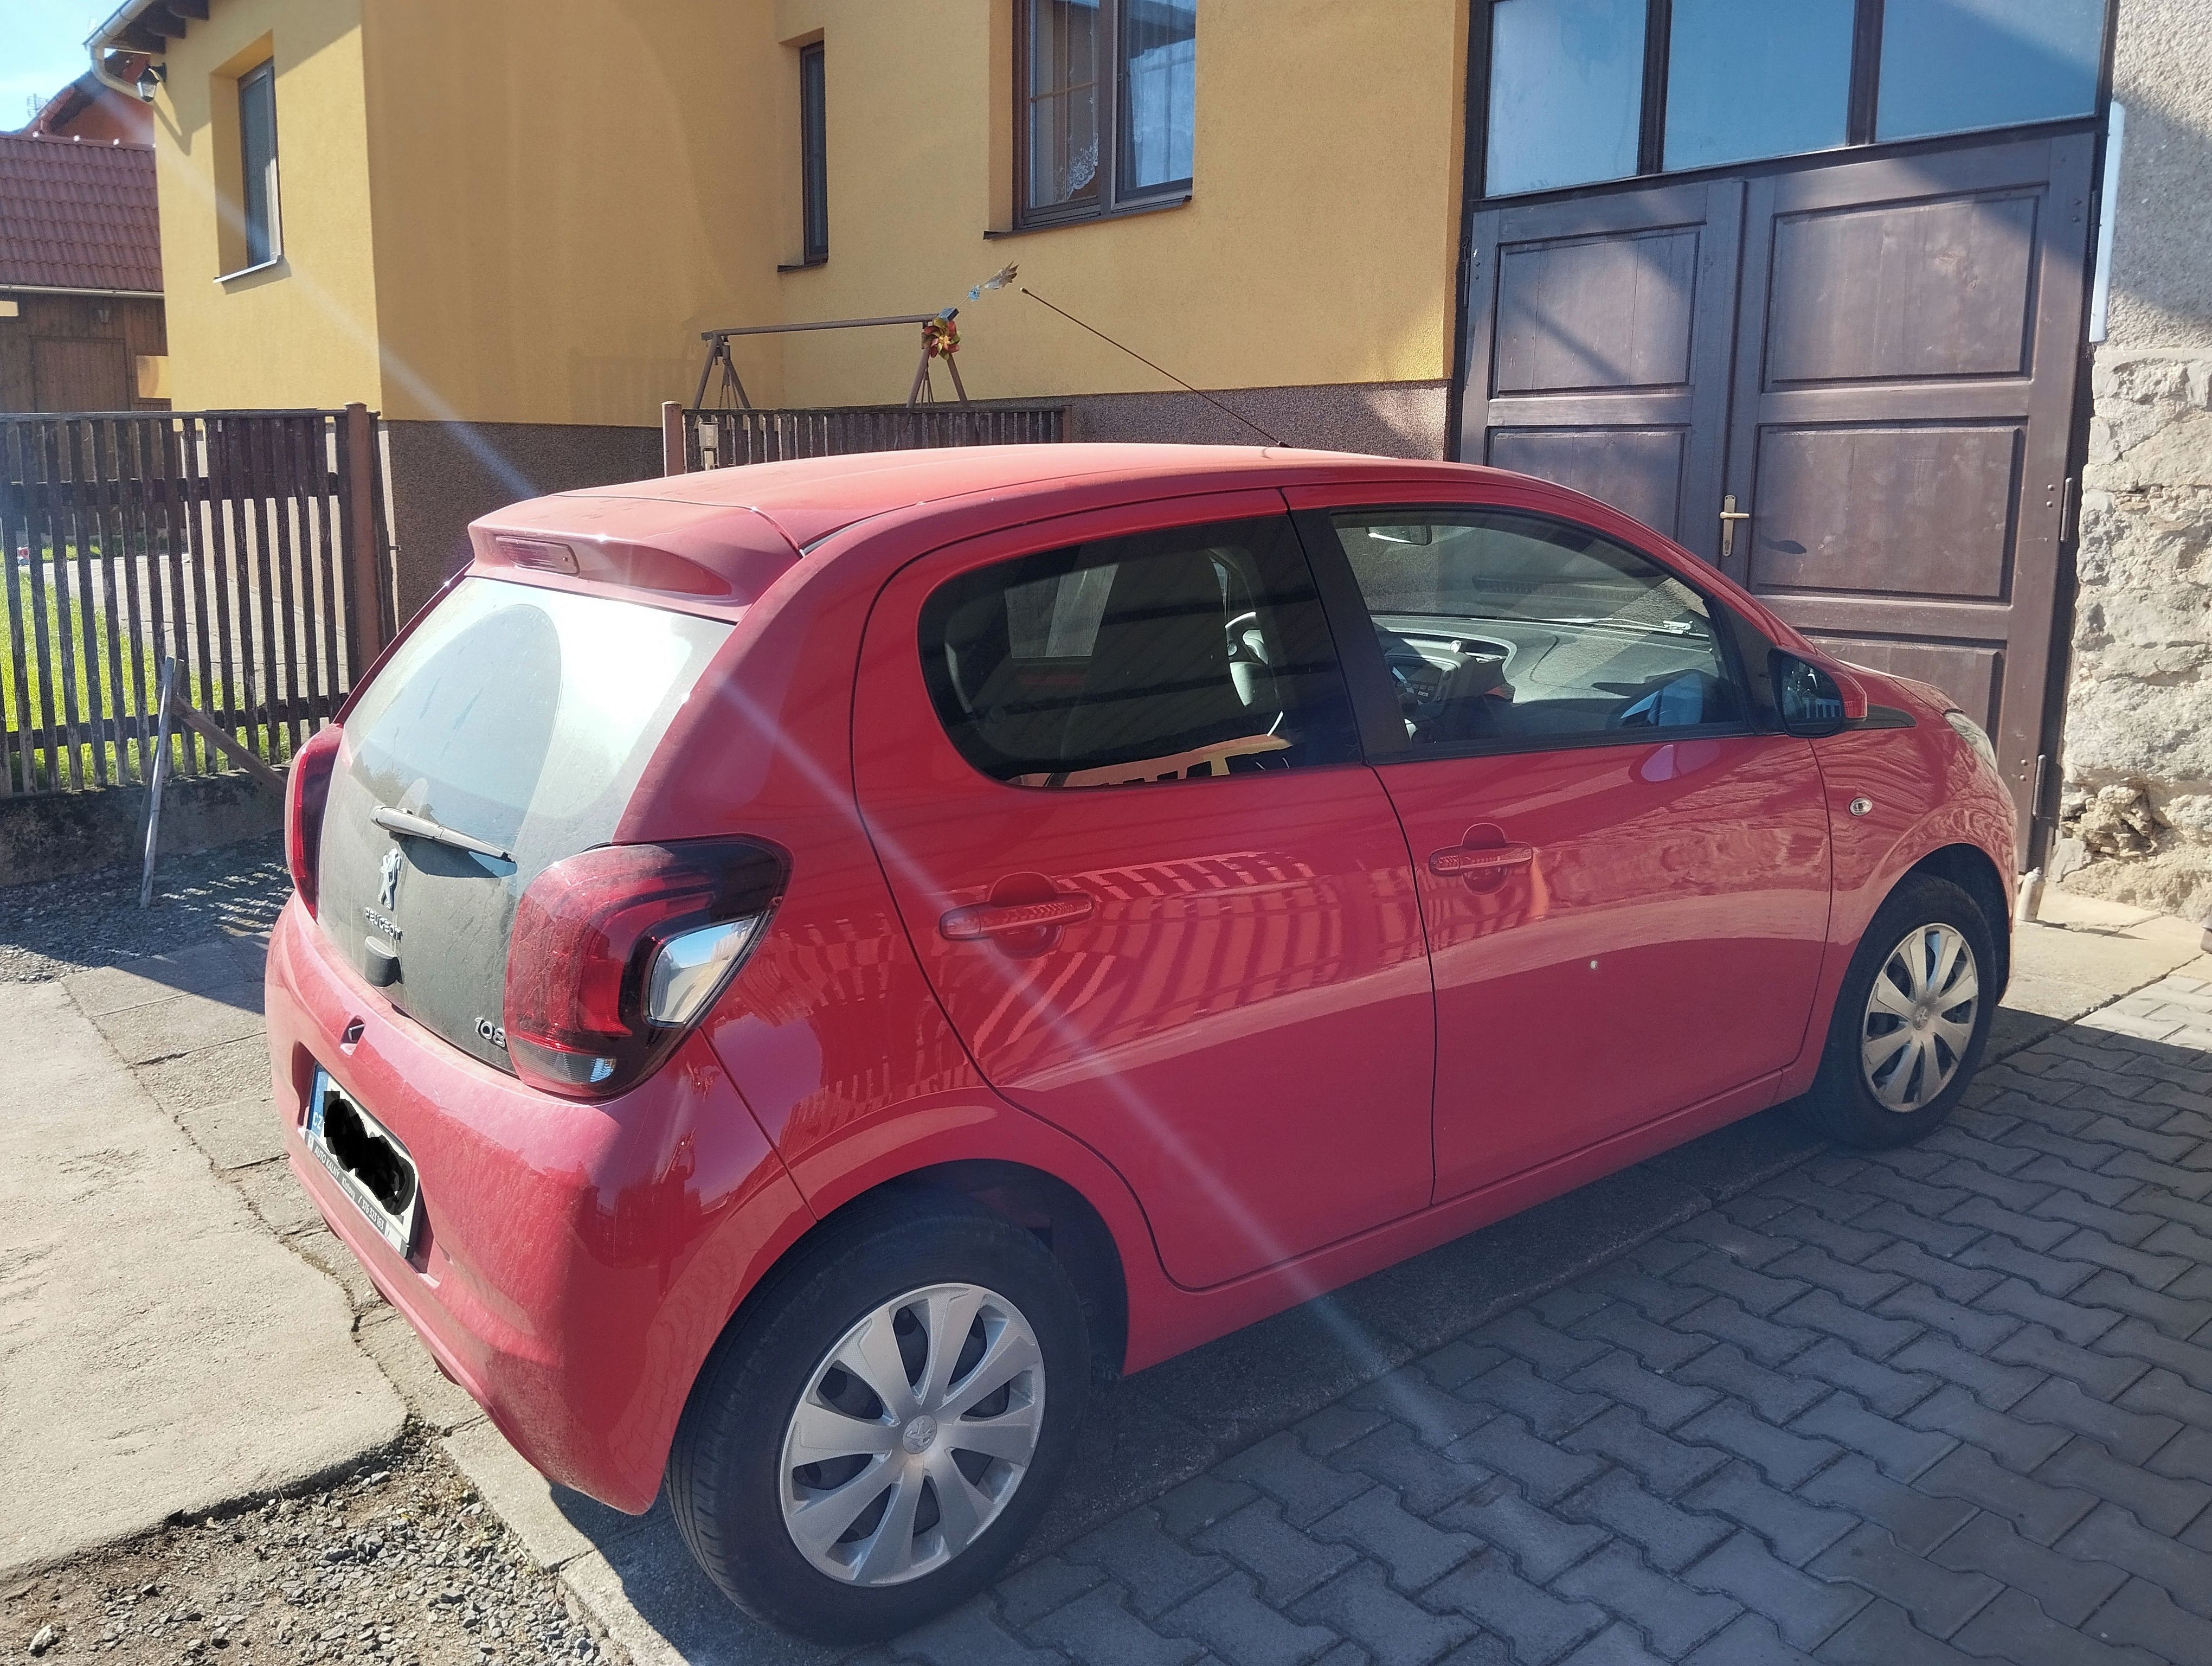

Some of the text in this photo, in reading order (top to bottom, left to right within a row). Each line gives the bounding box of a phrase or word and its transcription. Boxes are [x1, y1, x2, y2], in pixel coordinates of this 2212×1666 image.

[365, 907, 403, 940] PEUGEOT
[474, 1017, 505, 1047] 108
[313, 1112, 323, 1129] CZ
[314, 1145, 326, 1163] AUTO
